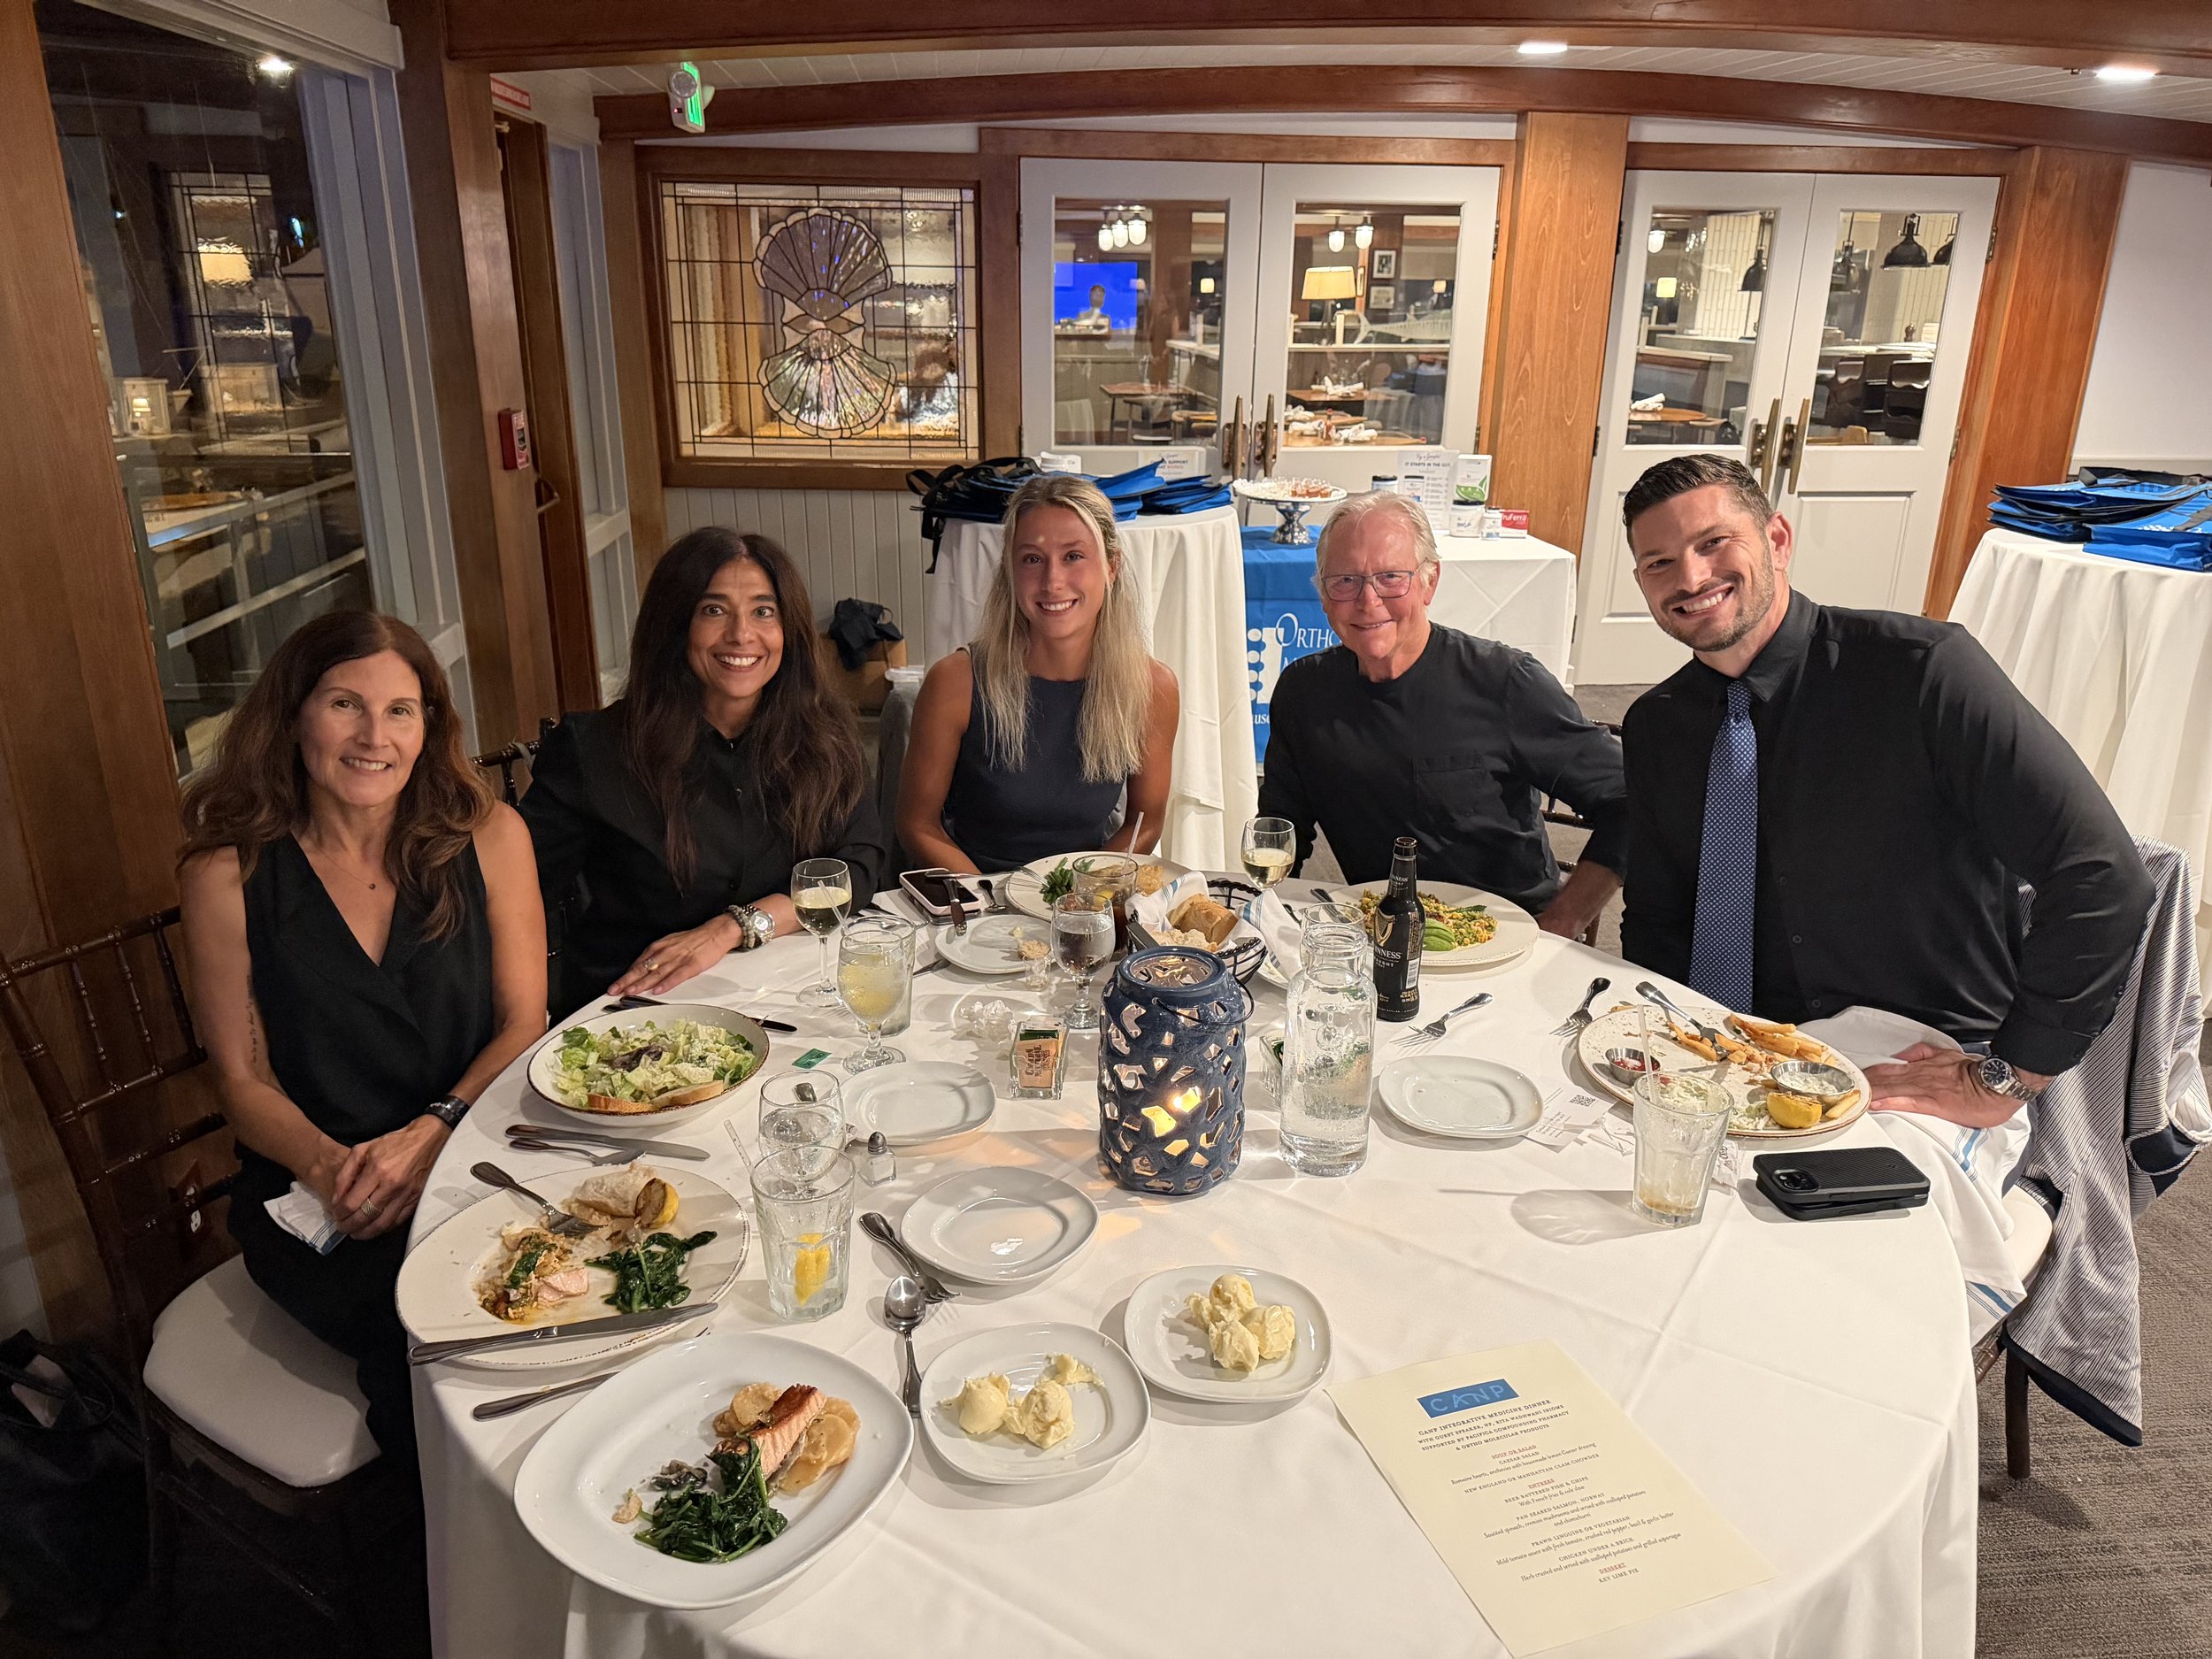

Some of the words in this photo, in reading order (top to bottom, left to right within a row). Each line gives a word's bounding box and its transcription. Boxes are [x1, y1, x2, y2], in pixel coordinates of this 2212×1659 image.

[1430, 1384, 1504, 1412] CANP
[1439, 1415, 1486, 1430] INTEGRATIVE
[1487, 1406, 1523, 1417] MEDICINE
[1523, 1400, 1551, 1409] DINNER
[1509, 1410, 1542, 1420] WADHWANI
[1421, 1440, 1455, 1450] SUPPORTED
[1465, 1430, 1493, 1440] PACIFICA
[1494, 1418, 1538, 1432] COMPOUNDING
[1538, 1410, 1571, 1421] PHARMACY
[1484, 1432, 1518, 1443] MOLECULAR
[1519, 1424, 1549, 1433] PRODUCTS
[1479, 1479, 1507, 1489] ENGLAND
[1517, 1466, 1553, 1479] MANHATTAN
[1571, 1454, 1599, 1463] CHOWDER
[1520, 1487, 1550, 1498] BATTERED
[1529, 1508, 1552, 1517] SEARED
[1580, 1493, 1605, 1502] NORWAY
[1553, 1529, 1584, 1540] LINGUINE
[1594, 1516, 1630, 1528] VEGETARIAN
[1558, 1550, 1587, 1561] CHICKEN
[1587, 1544, 1609, 1553] UNDER
[1598, 1563, 1626, 1573] DESSERT
